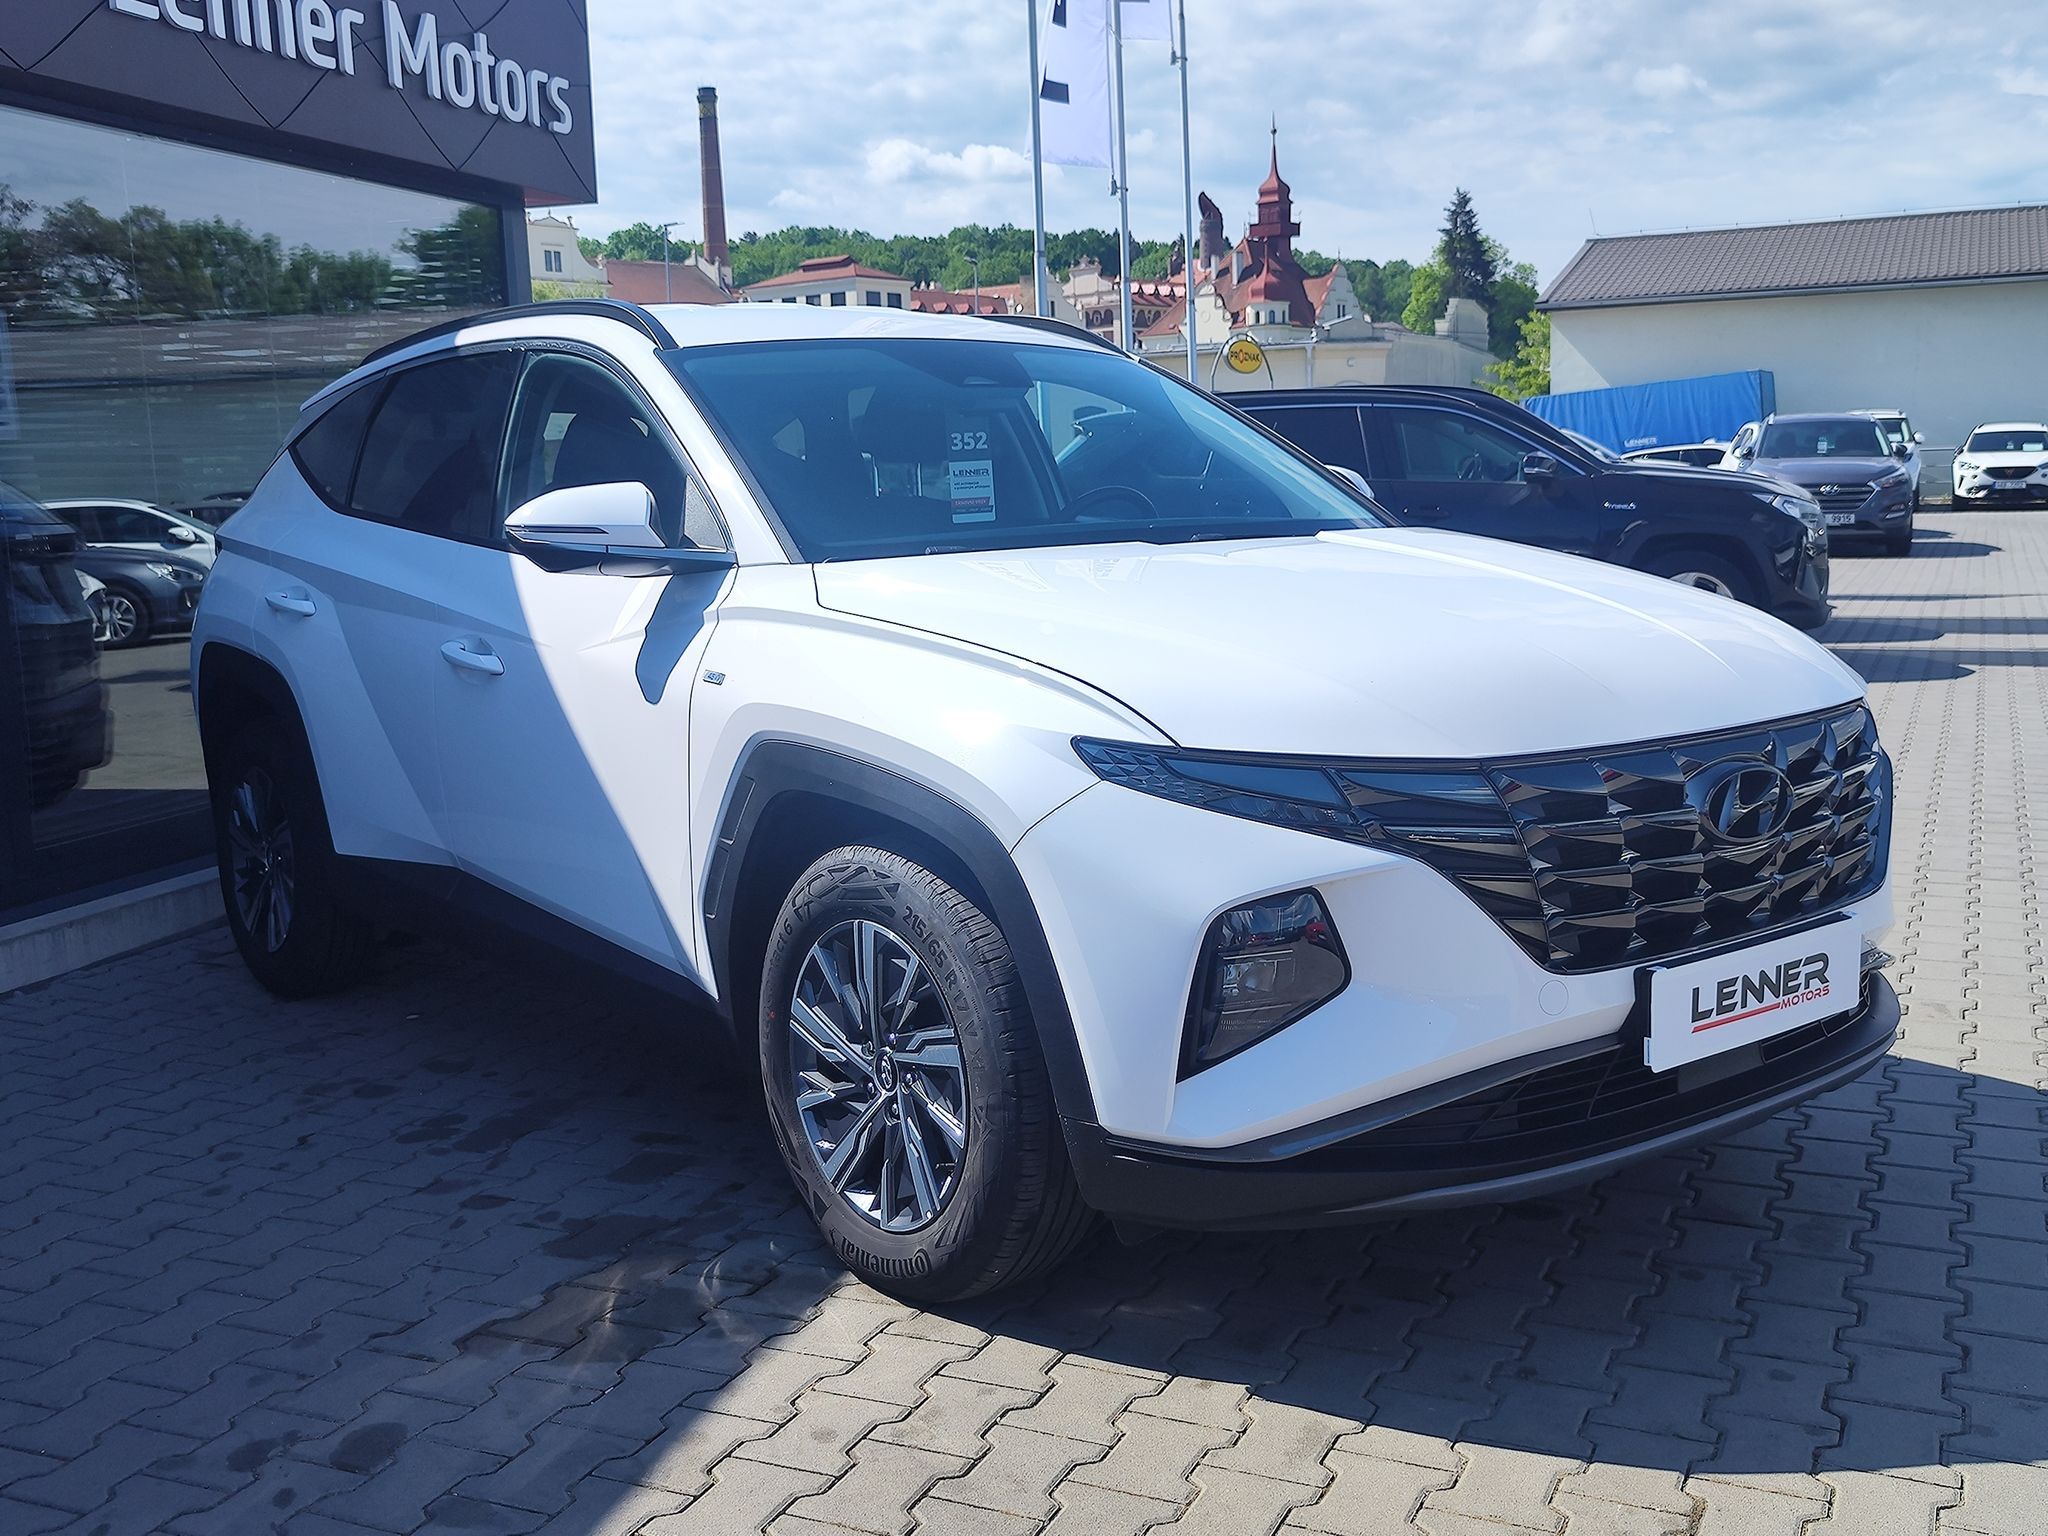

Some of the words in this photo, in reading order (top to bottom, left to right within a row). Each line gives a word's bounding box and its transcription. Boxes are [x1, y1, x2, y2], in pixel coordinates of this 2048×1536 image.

[383, 0, 573, 135] Motors
[950, 431, 989, 451] 352
[902, 905, 948, 968] 215/65
[1691, 952, 1830, 1023] LENNER
[1780, 984, 1830, 1010] MOTORS
[840, 1236, 932, 1277] Continental
